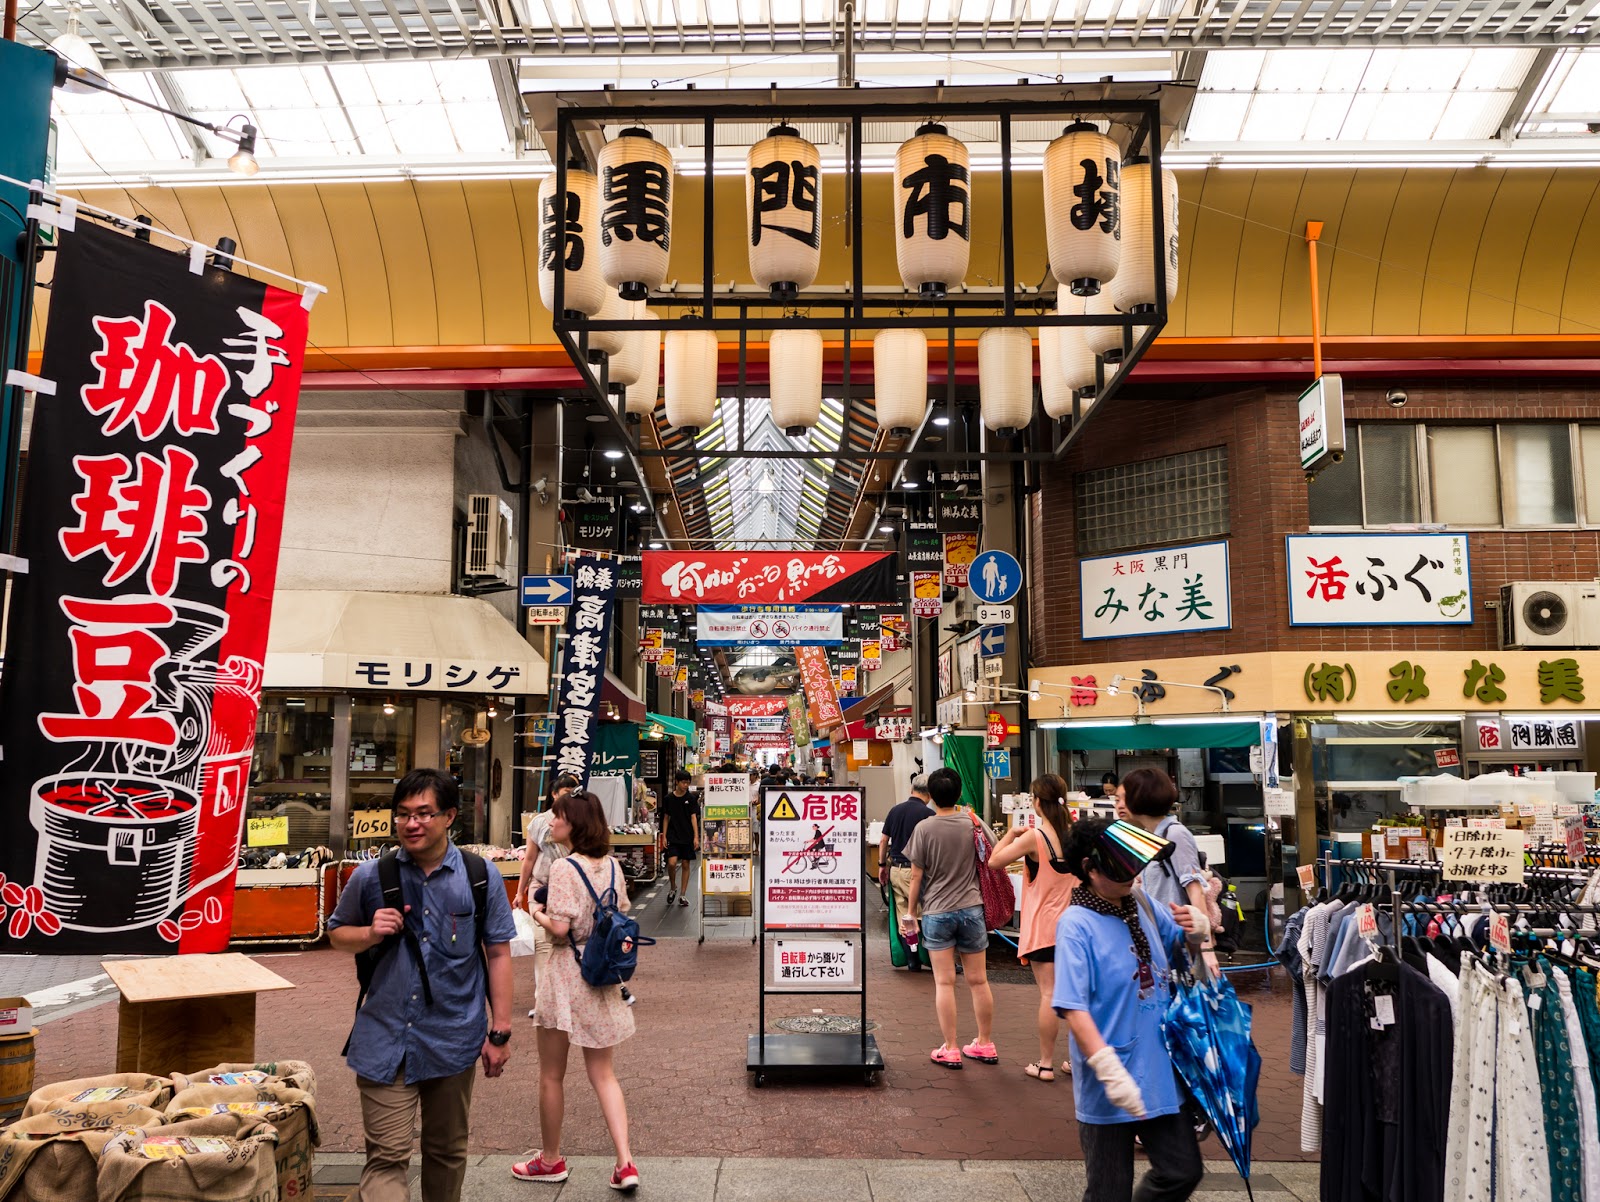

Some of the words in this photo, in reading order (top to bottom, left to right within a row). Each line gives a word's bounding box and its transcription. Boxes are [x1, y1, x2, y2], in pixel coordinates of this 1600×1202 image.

[600, 160, 670, 252] 黒
[751, 159, 819, 251] 門
[902, 153, 968, 241] 市
[209, 305, 291, 594] 手づくりの
[37, 299, 231, 746] 珈琲豆
[579, 526, 613, 538] モリシゲ
[1452, 537, 1464, 577] 黒門市場
[1305, 553, 1444, 603] 活ふぐ
[530, 608, 564, 617] 自転車を除く
[1094, 573, 1215, 624] みな美
[355, 662, 520, 690] モリシゲ
[591, 751, 630, 765] カレー
[801, 793, 858, 821] 危険
[355, 819, 388, 834] 1050
[709, 863, 746, 871] 自転車から降りて
[781, 952, 846, 964] 自転車から降りて
[781, 966, 844, 978] 通行して下さい
